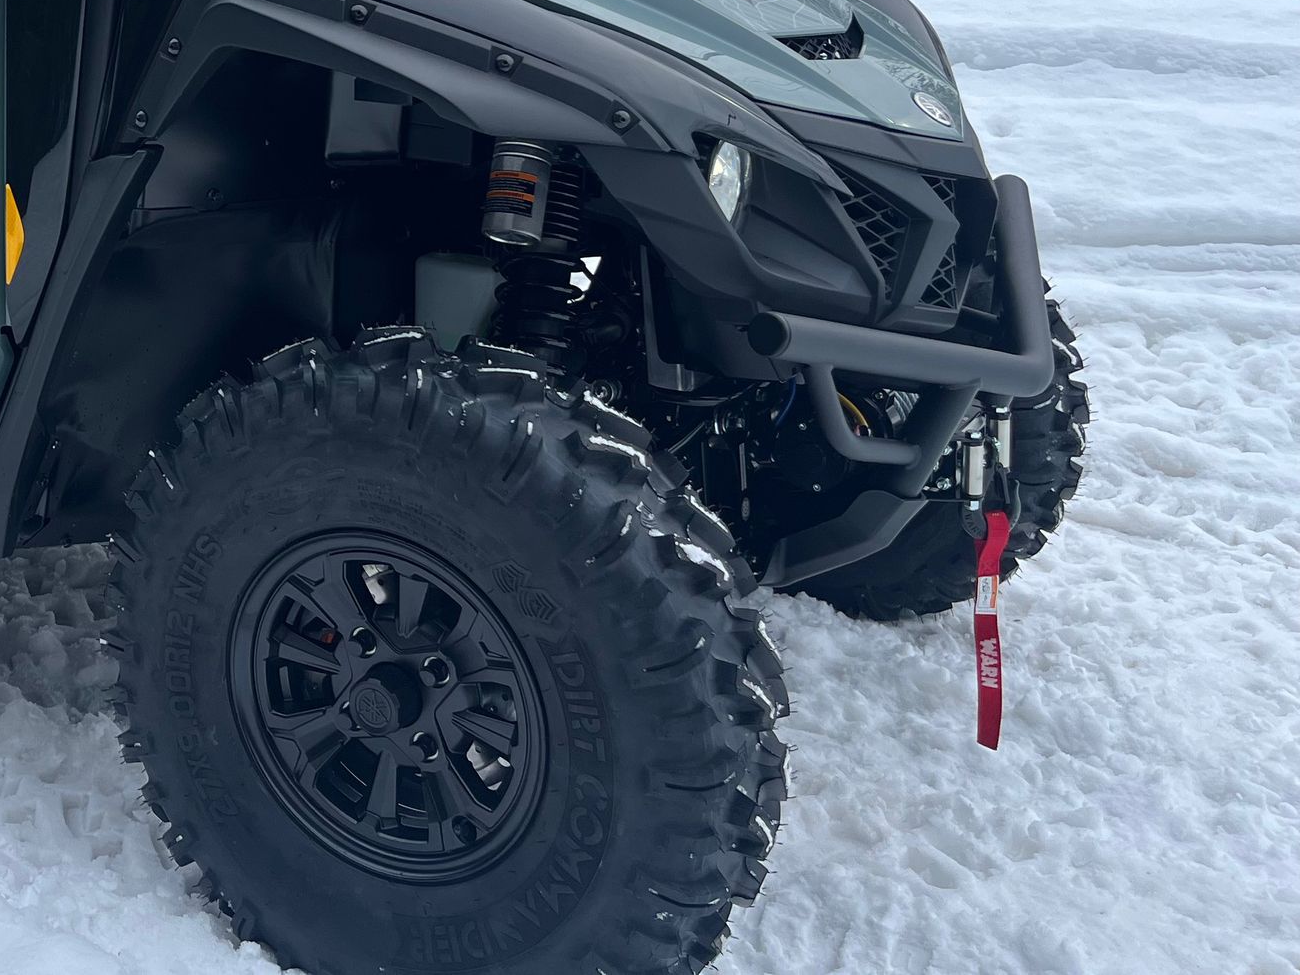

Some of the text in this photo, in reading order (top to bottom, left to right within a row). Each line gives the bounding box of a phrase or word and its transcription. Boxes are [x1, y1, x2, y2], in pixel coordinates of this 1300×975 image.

[174, 534, 223, 603] NHS
[979, 637, 999, 689] WARN
[409, 652, 609, 963] DIRT COMMANDER
